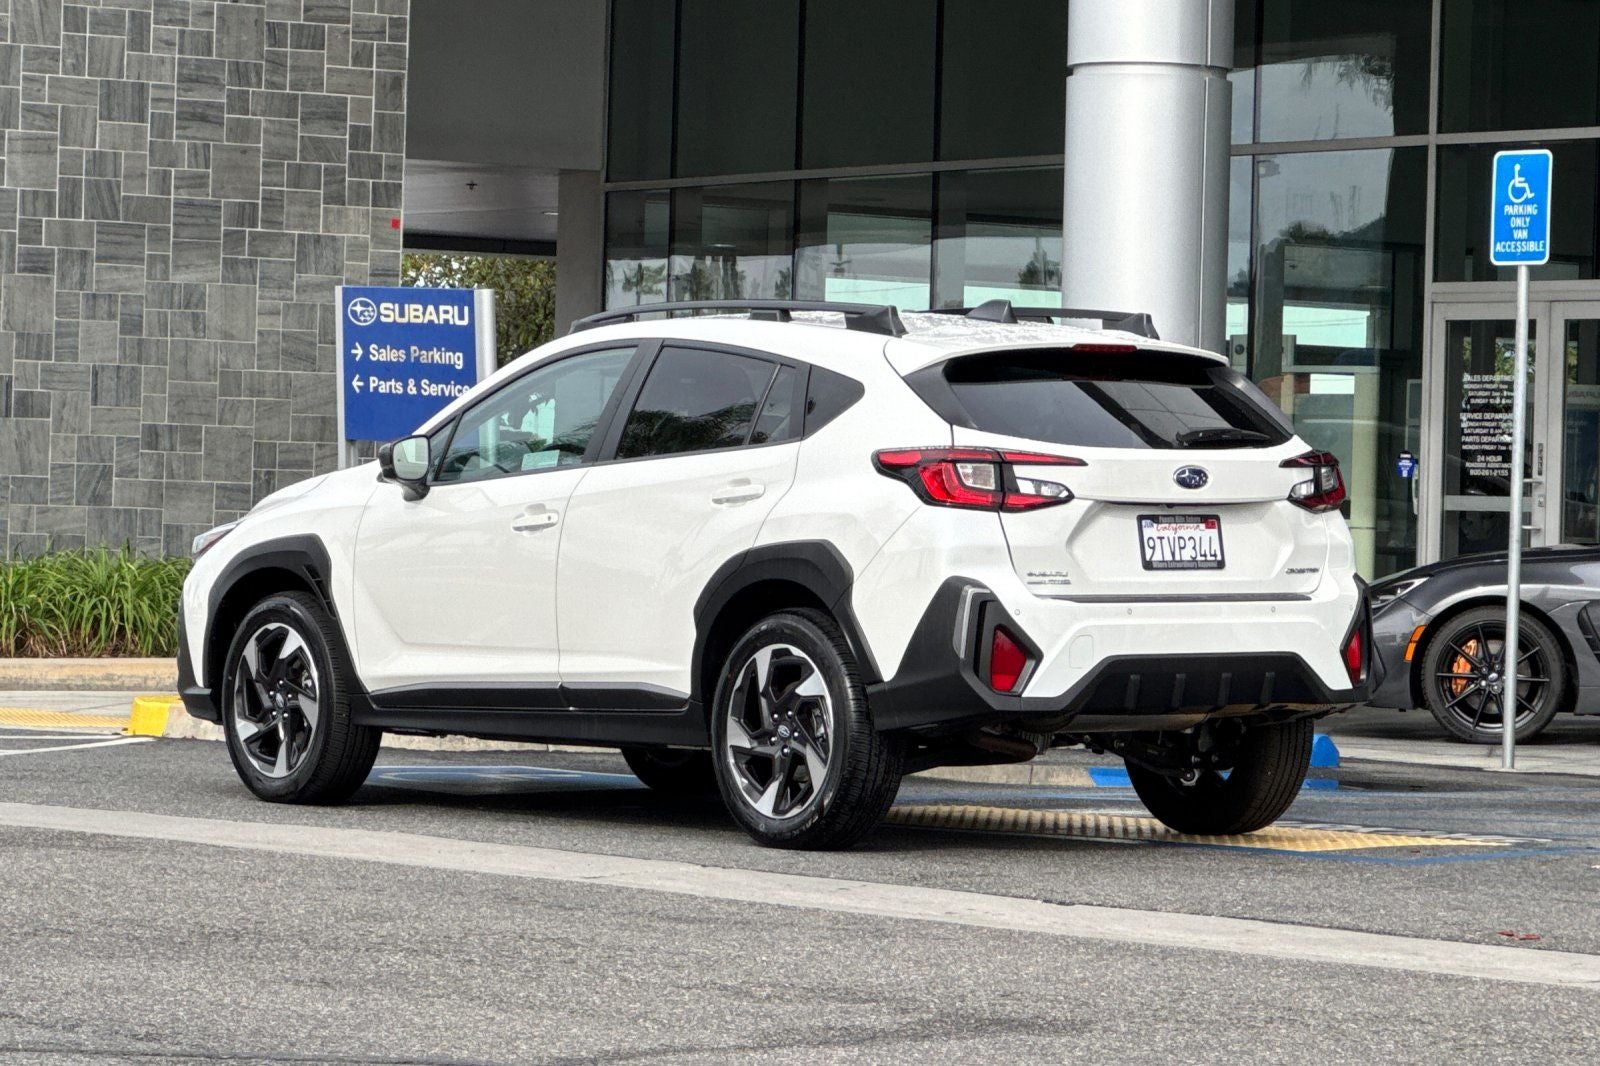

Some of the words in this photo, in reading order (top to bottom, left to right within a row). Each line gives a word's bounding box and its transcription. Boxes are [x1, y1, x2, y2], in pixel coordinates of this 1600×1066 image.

[1504, 204, 1538, 216] PARKING
[1510, 216, 1531, 228] ONLY
[1513, 228, 1529, 240] VAN
[1495, 240, 1545, 252] ACCESSIBLE
[379, 302, 469, 326] SUBARU
[369, 343, 406, 362] Sales
[410, 346, 464, 370] Parking
[369, 376, 404, 395] Parts
[407, 378, 417, 395] &
[421, 379, 471, 398] Service
[1461, 435, 1480, 443] PARTS
[1143, 521, 1154, 529] JUN
[1156, 523, 1203, 535] California
[1146, 536, 1218, 561] 9TVP344
